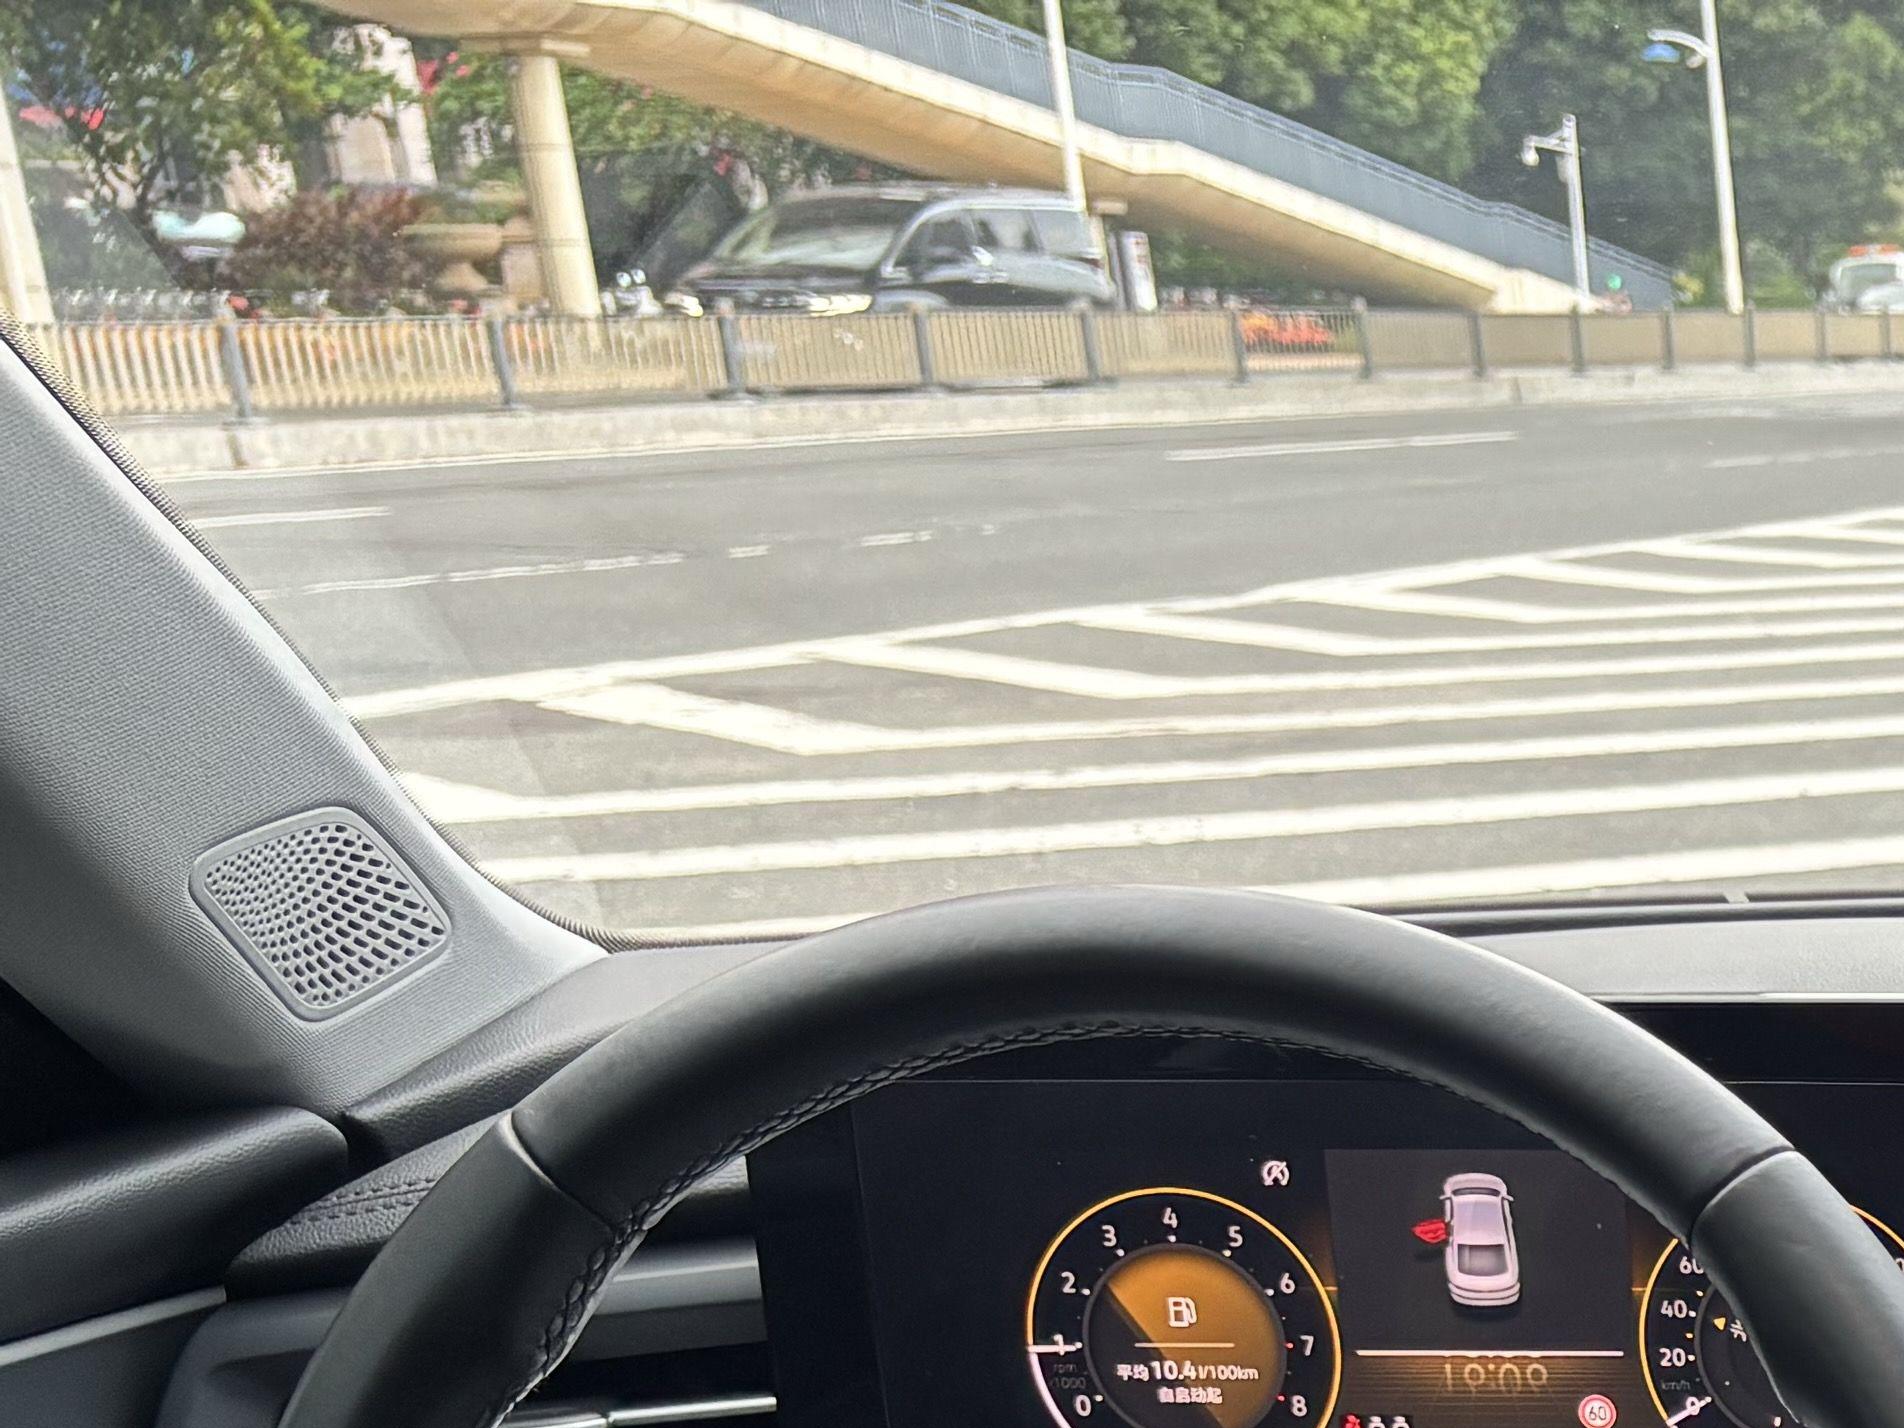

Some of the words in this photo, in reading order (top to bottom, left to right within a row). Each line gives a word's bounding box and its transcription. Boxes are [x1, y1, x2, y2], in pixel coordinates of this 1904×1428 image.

[1162, 1207, 1178, 1229] 4
[1101, 1225, 1116, 1247] 3
[1228, 1225, 1243, 1247] 5
[1060, 1271, 1077, 1294] 2
[1280, 1272, 1296, 1294] 6
[1660, 1299, 1687, 1319] 40
[1300, 1334, 1314, 1357] 7
[1659, 1347, 1686, 1367] 20
[1075, 1395, 1092, 1417] 0
[1292, 1395, 1308, 1417] 8
[1588, 1405, 1608, 1421] 60
